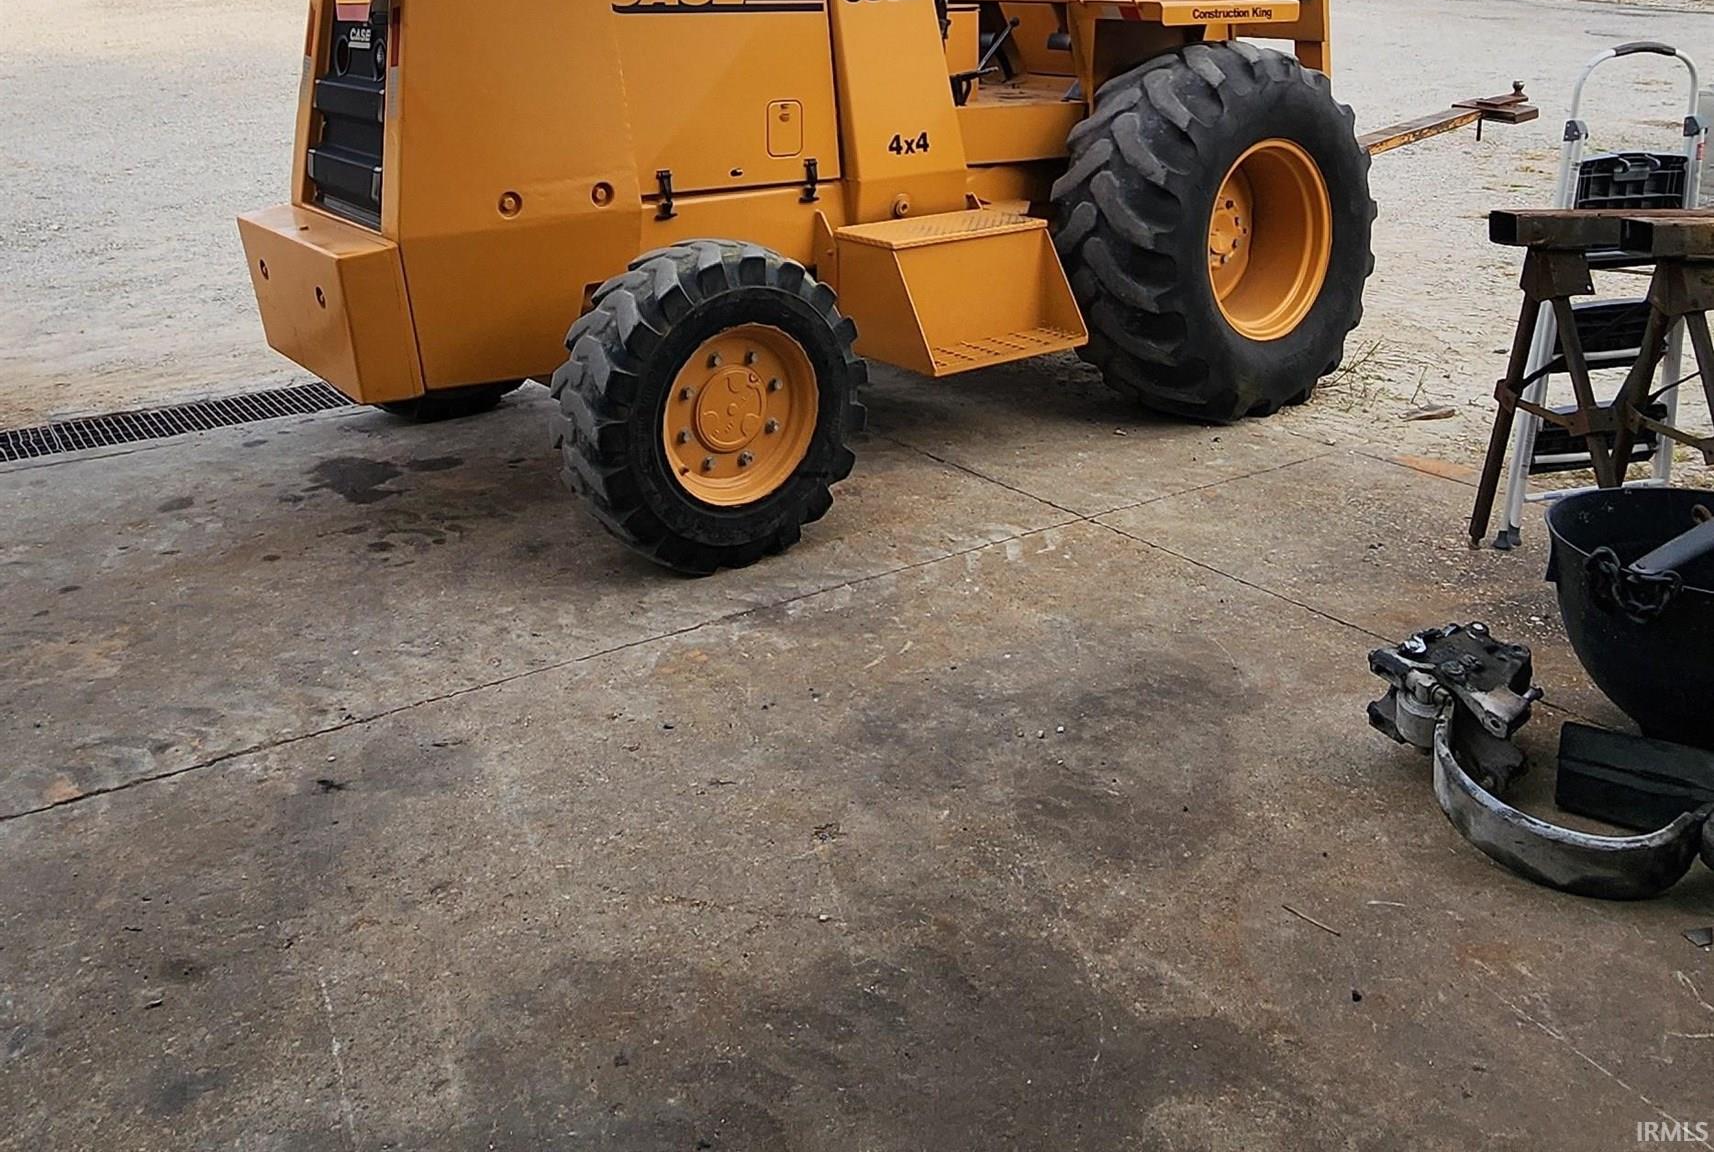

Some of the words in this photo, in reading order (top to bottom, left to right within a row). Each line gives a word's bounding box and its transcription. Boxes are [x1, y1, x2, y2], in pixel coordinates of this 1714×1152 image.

[1192, 8, 1249, 19] Construction
[1252, 8, 1272, 19] King
[349, 28, 371, 41] CASE
[888, 132, 930, 155] 4x4
